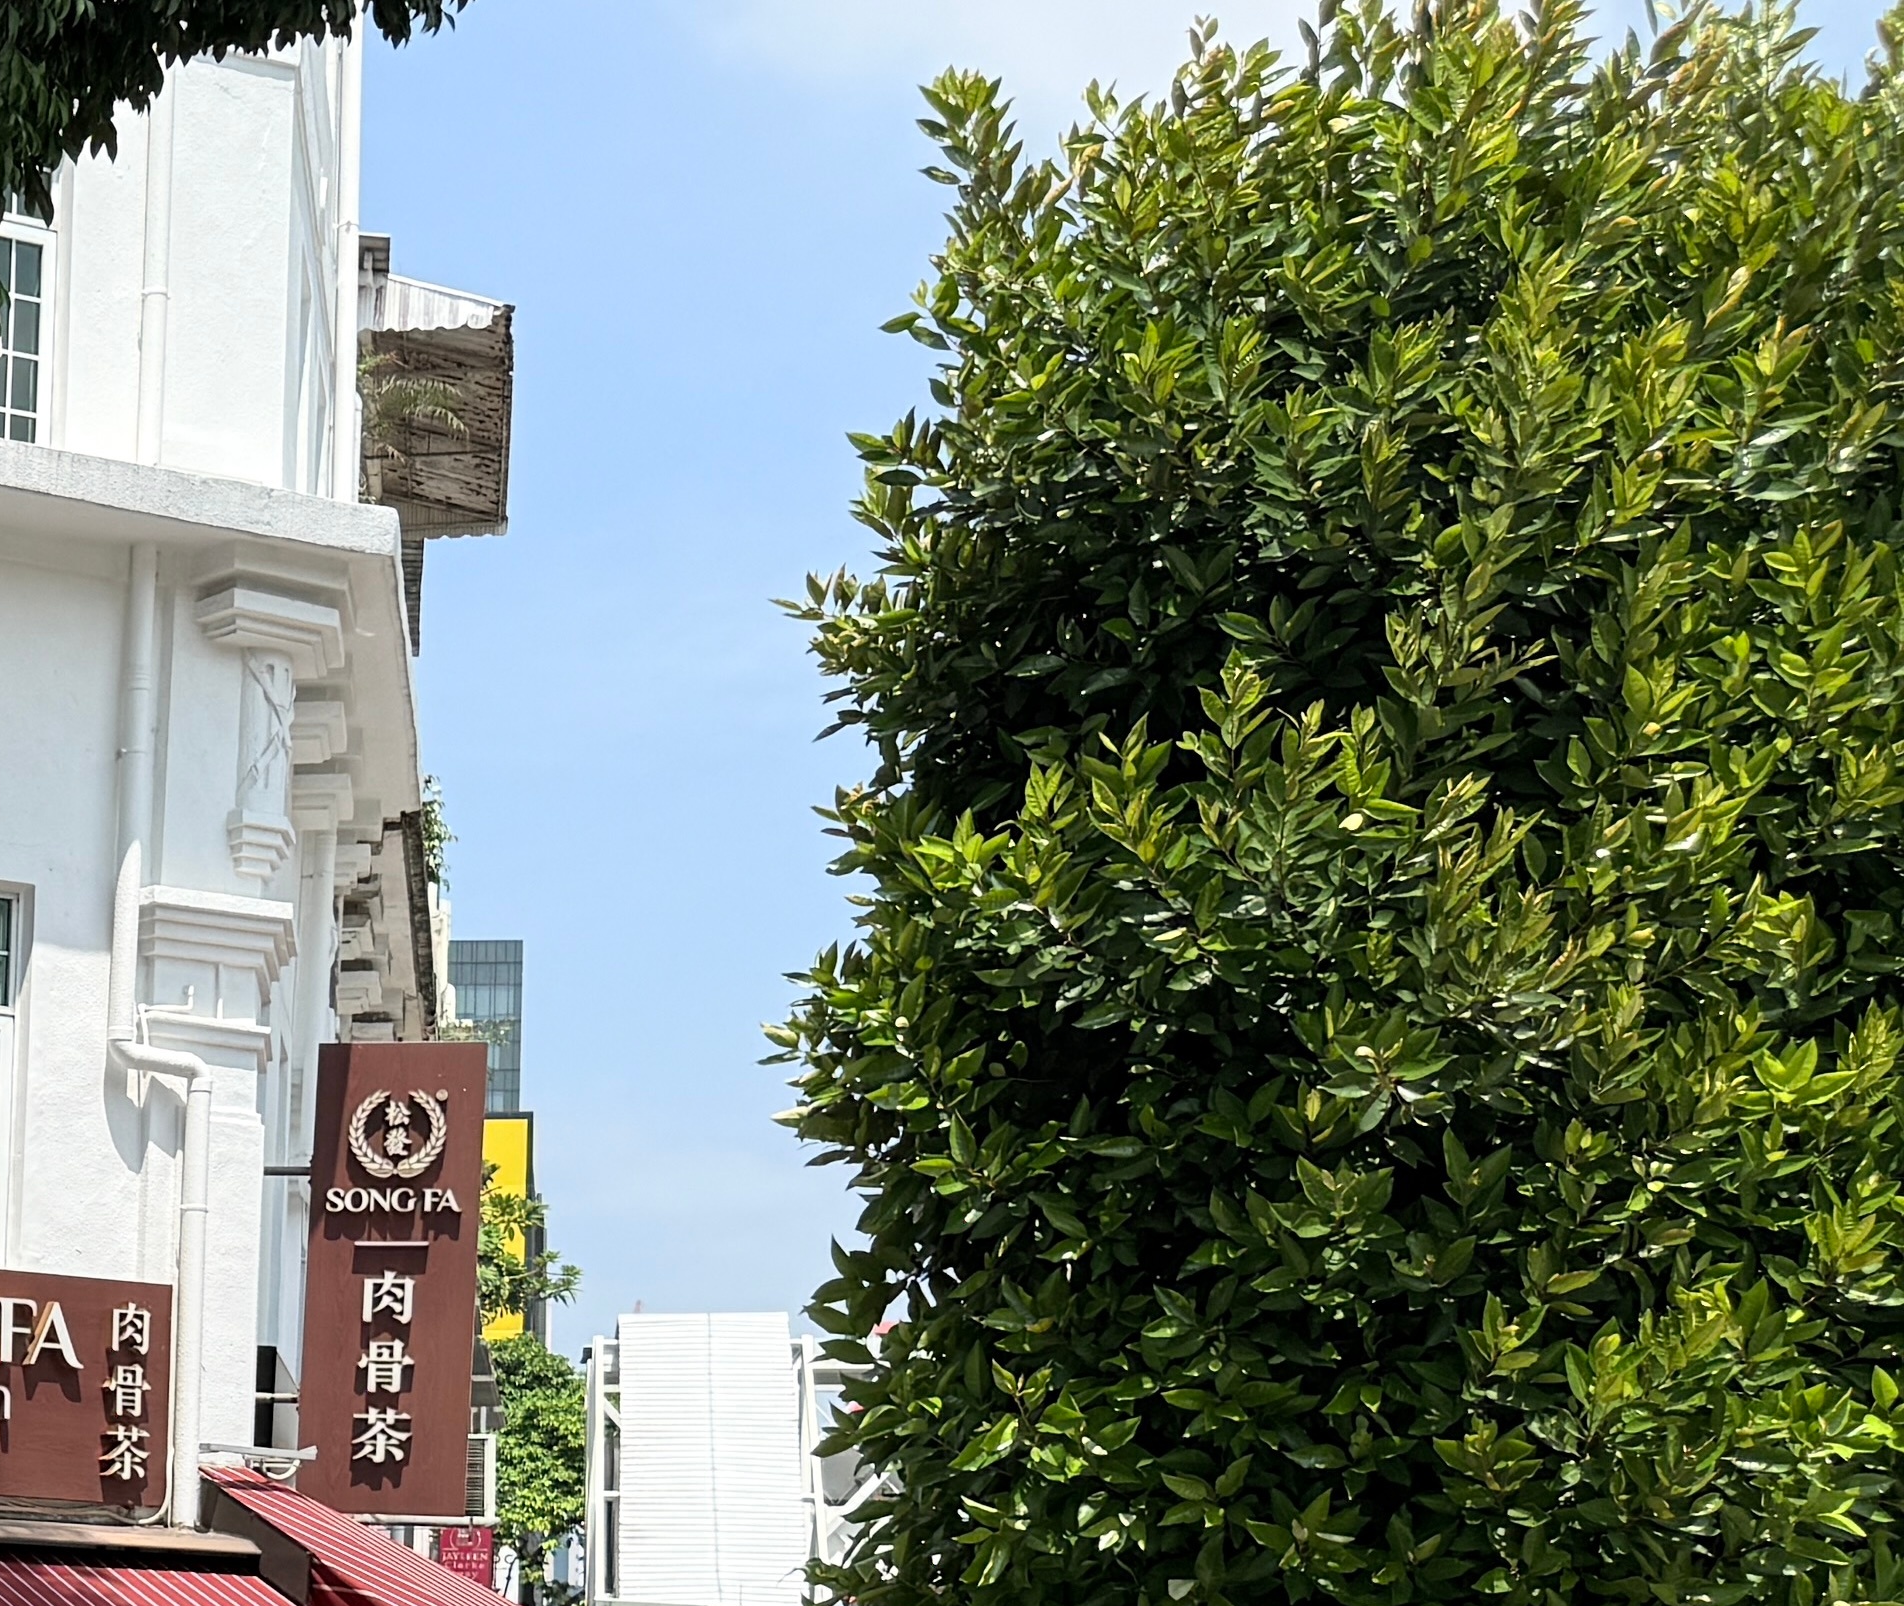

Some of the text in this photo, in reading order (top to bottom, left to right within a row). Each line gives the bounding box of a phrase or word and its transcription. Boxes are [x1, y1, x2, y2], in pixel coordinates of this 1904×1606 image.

[325, 1187, 463, 1214] SONG FA
[98, 1301, 152, 1480] 肉骨茶
[351, 1270, 416, 1464] 肉骨茶
